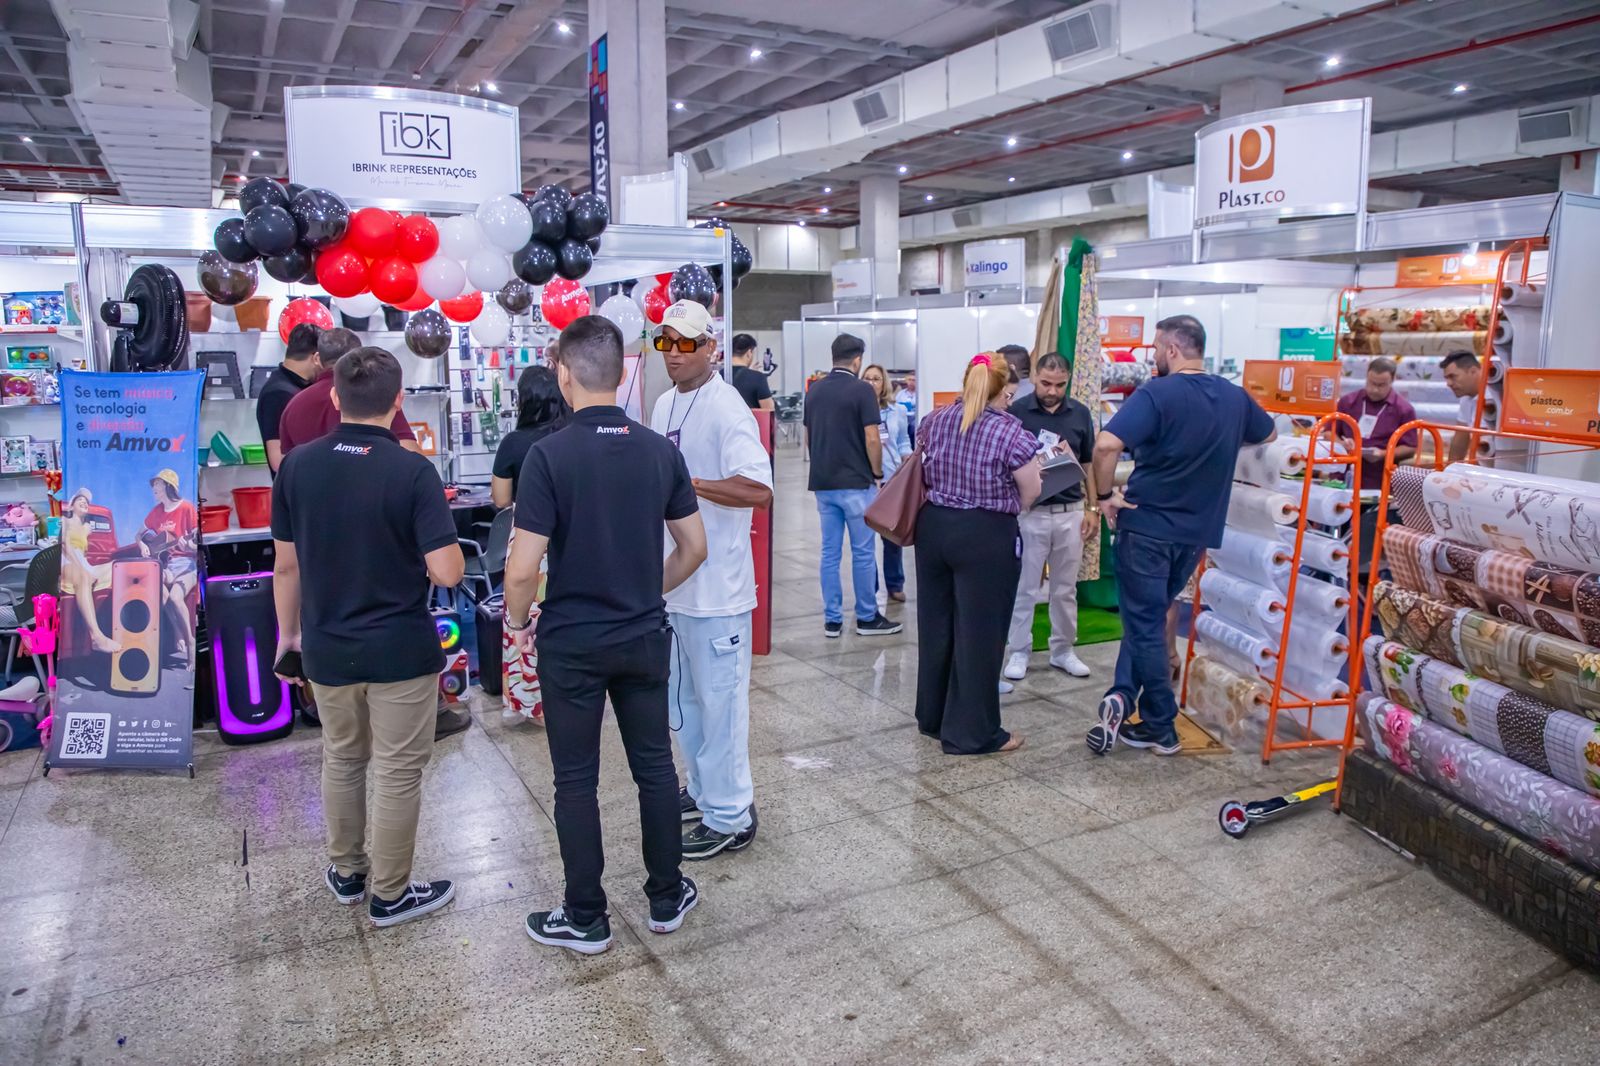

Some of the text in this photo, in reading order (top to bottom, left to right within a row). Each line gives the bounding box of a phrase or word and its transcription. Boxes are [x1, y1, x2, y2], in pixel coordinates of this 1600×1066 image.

[391, 112, 443, 151] ibk
[352, 163, 477, 179] IBRINK REPRESENTAÇÕES
[970, 261, 1008, 274] xalingo
[74, 385, 91, 398] Se
[94, 387, 120, 398] tem
[1530, 396, 1563, 406] plastco
[76, 402, 146, 417] tecnologia
[76, 422, 84, 431] e
[596, 425, 630, 434] Amvox
[77, 432, 186, 452] tem Amvox
[333, 442, 372, 454] Amvox
